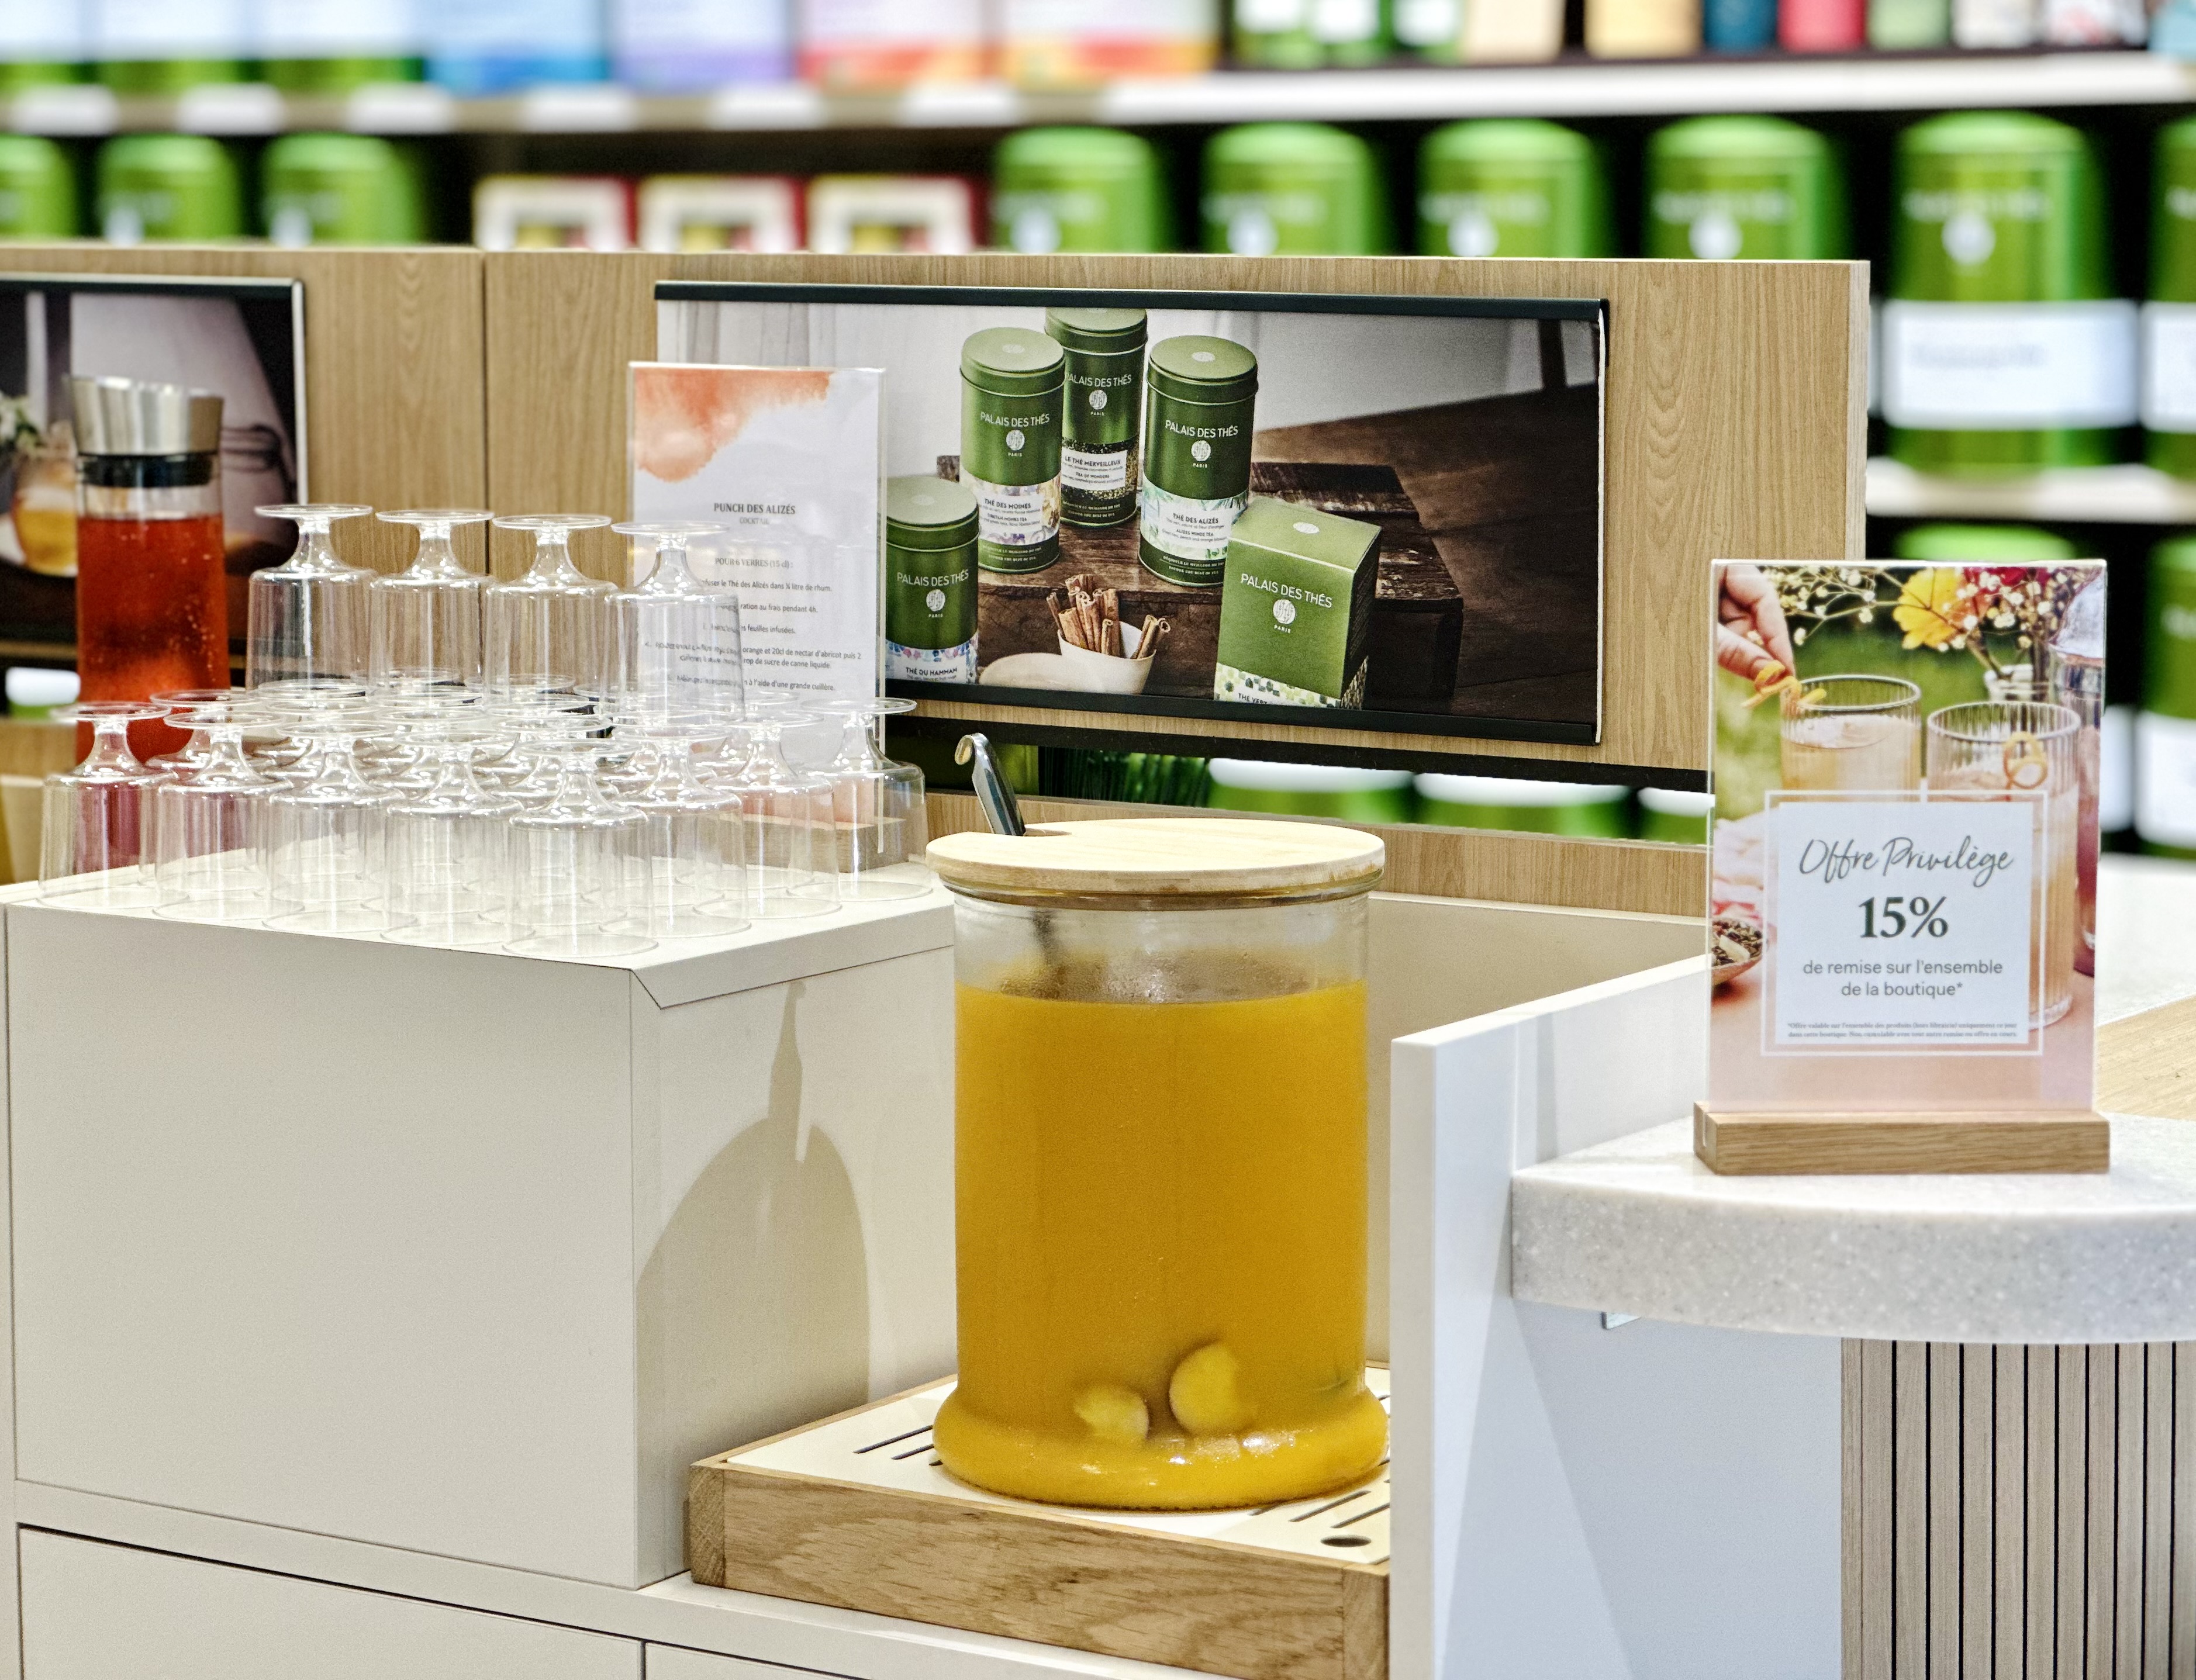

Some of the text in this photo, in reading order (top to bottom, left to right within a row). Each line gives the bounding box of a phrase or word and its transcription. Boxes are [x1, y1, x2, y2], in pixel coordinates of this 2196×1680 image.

[1094, 378, 1111, 387] DES
[1113, 374, 1132, 386] THÉS
[980, 411, 1050, 427] PALAIS DES THÉS
[1165, 420, 1238, 438] PALAIS DES THÉS
[714, 503, 796, 514] PUNCH DES ALIZÉS
[1173, 513, 1184, 521] THÉ
[715, 557, 735, 565] POUR
[897, 569, 969, 586] PALAIS DES THÉS
[805, 583, 813, 591] de
[814, 583, 833, 592] rhum.
[1241, 573, 1332, 609] PALAIS DES THÉS
[782, 604, 807, 613] pendant
[747, 624, 768, 632] feuilles
[815, 649, 841, 658] d'abricot
[843, 652, 856, 660] puis
[781, 658, 789, 666] de
[906, 666, 917, 675] THÉ
[930, 666, 958, 676] HAMMAM
[754, 678, 770, 686] l'aide
[771, 680, 788, 688] d'une
[789, 682, 810, 690] grande
[1799, 835, 2015, 888] Offre Privilège
[1859, 896, 1949, 938] 15%
[1803, 959, 2003, 974] de remise sur l'ensemble
[1841, 981, 1861, 995] de
[1866, 981, 1879, 995] la
